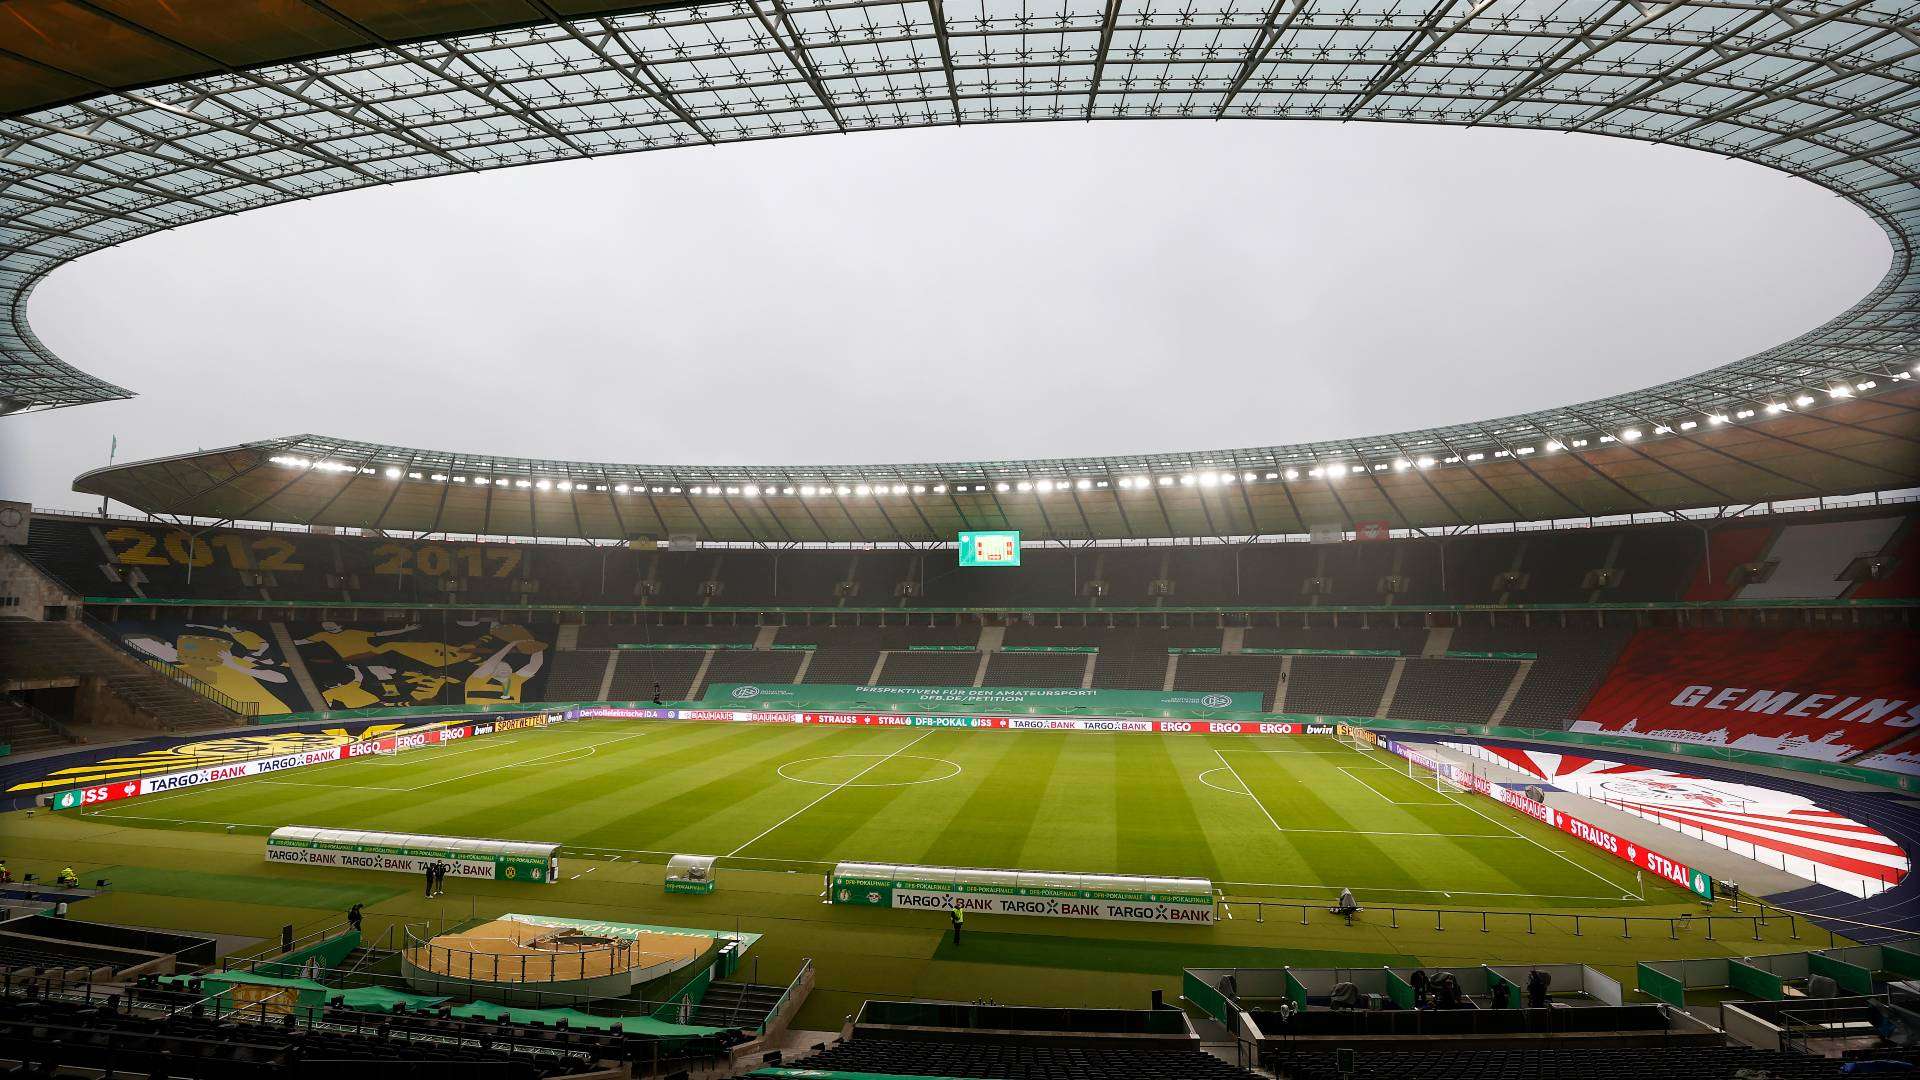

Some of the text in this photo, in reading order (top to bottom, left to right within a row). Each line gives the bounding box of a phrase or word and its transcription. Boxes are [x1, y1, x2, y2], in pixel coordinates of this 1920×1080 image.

[105, 527, 304, 571] 2012
[374, 545, 522, 577] 2017
[855, 686, 939, 695] PERSPEKTIVEN
[942, 688, 966, 696] FÜR
[919, 694, 1024, 702] DFB.DE/PETITION
[1670, 685, 1920, 728] GEMEINS
[548, 712, 563, 724] bwin
[579, 709, 593, 717] Der
[690, 711, 734, 720] BAUHAUS
[752, 713, 796, 722] BAUHAUS
[498, 714, 548, 732] SPORTWETTEN
[818, 715, 857, 724] STRAUSS
[915, 717, 967, 727] DFB-POKAL
[440, 726, 464, 740] ERGO
[474, 724, 493, 736] bwin
[1160, 722, 1191, 733] ERGO
[1209, 723, 1241, 734] ERGO
[1259, 723, 1292, 735] ERGO
[1306, 725, 1333, 735] bwin
[397, 734, 424, 749] ERGO
[349, 741, 380, 757] ERGO
[1505, 788, 1547, 821] BAUHAUS
[1570, 819, 1618, 853] STRAUSS
[845, 878, 891, 888] DFB-POKALFINALE
